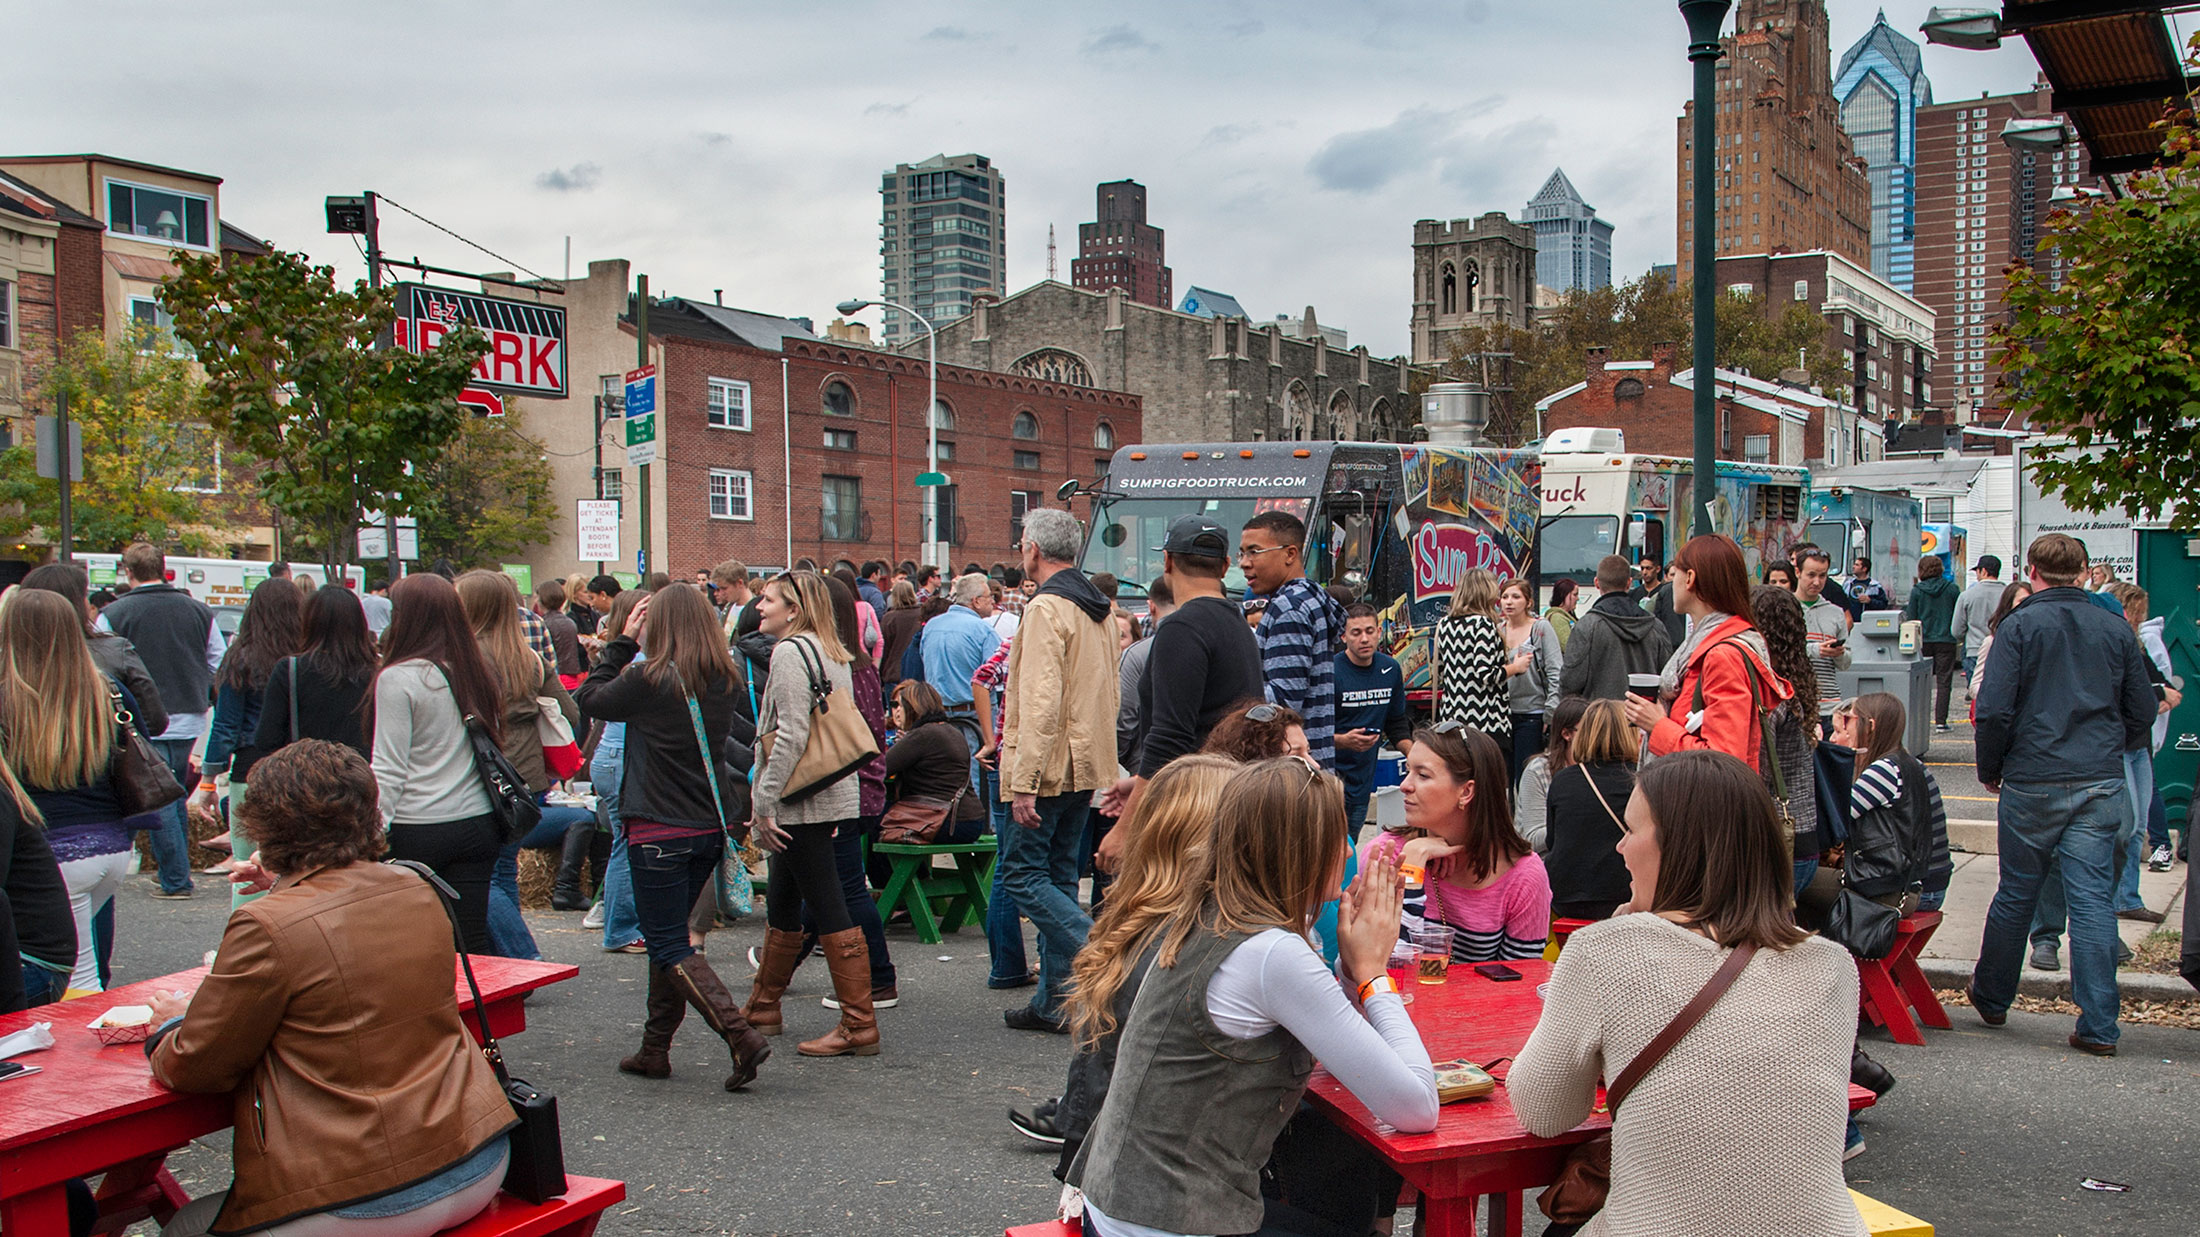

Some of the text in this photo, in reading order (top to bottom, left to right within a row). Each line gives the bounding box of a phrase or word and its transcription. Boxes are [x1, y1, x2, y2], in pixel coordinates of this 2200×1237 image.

[429, 301, 458, 321] E-Z
[1119, 476, 1307, 489] SUMPIGFOODTRUCK.COM
[2037, 521, 2130, 532] Household & Business
[1342, 687, 1393, 701] PENN STATE
